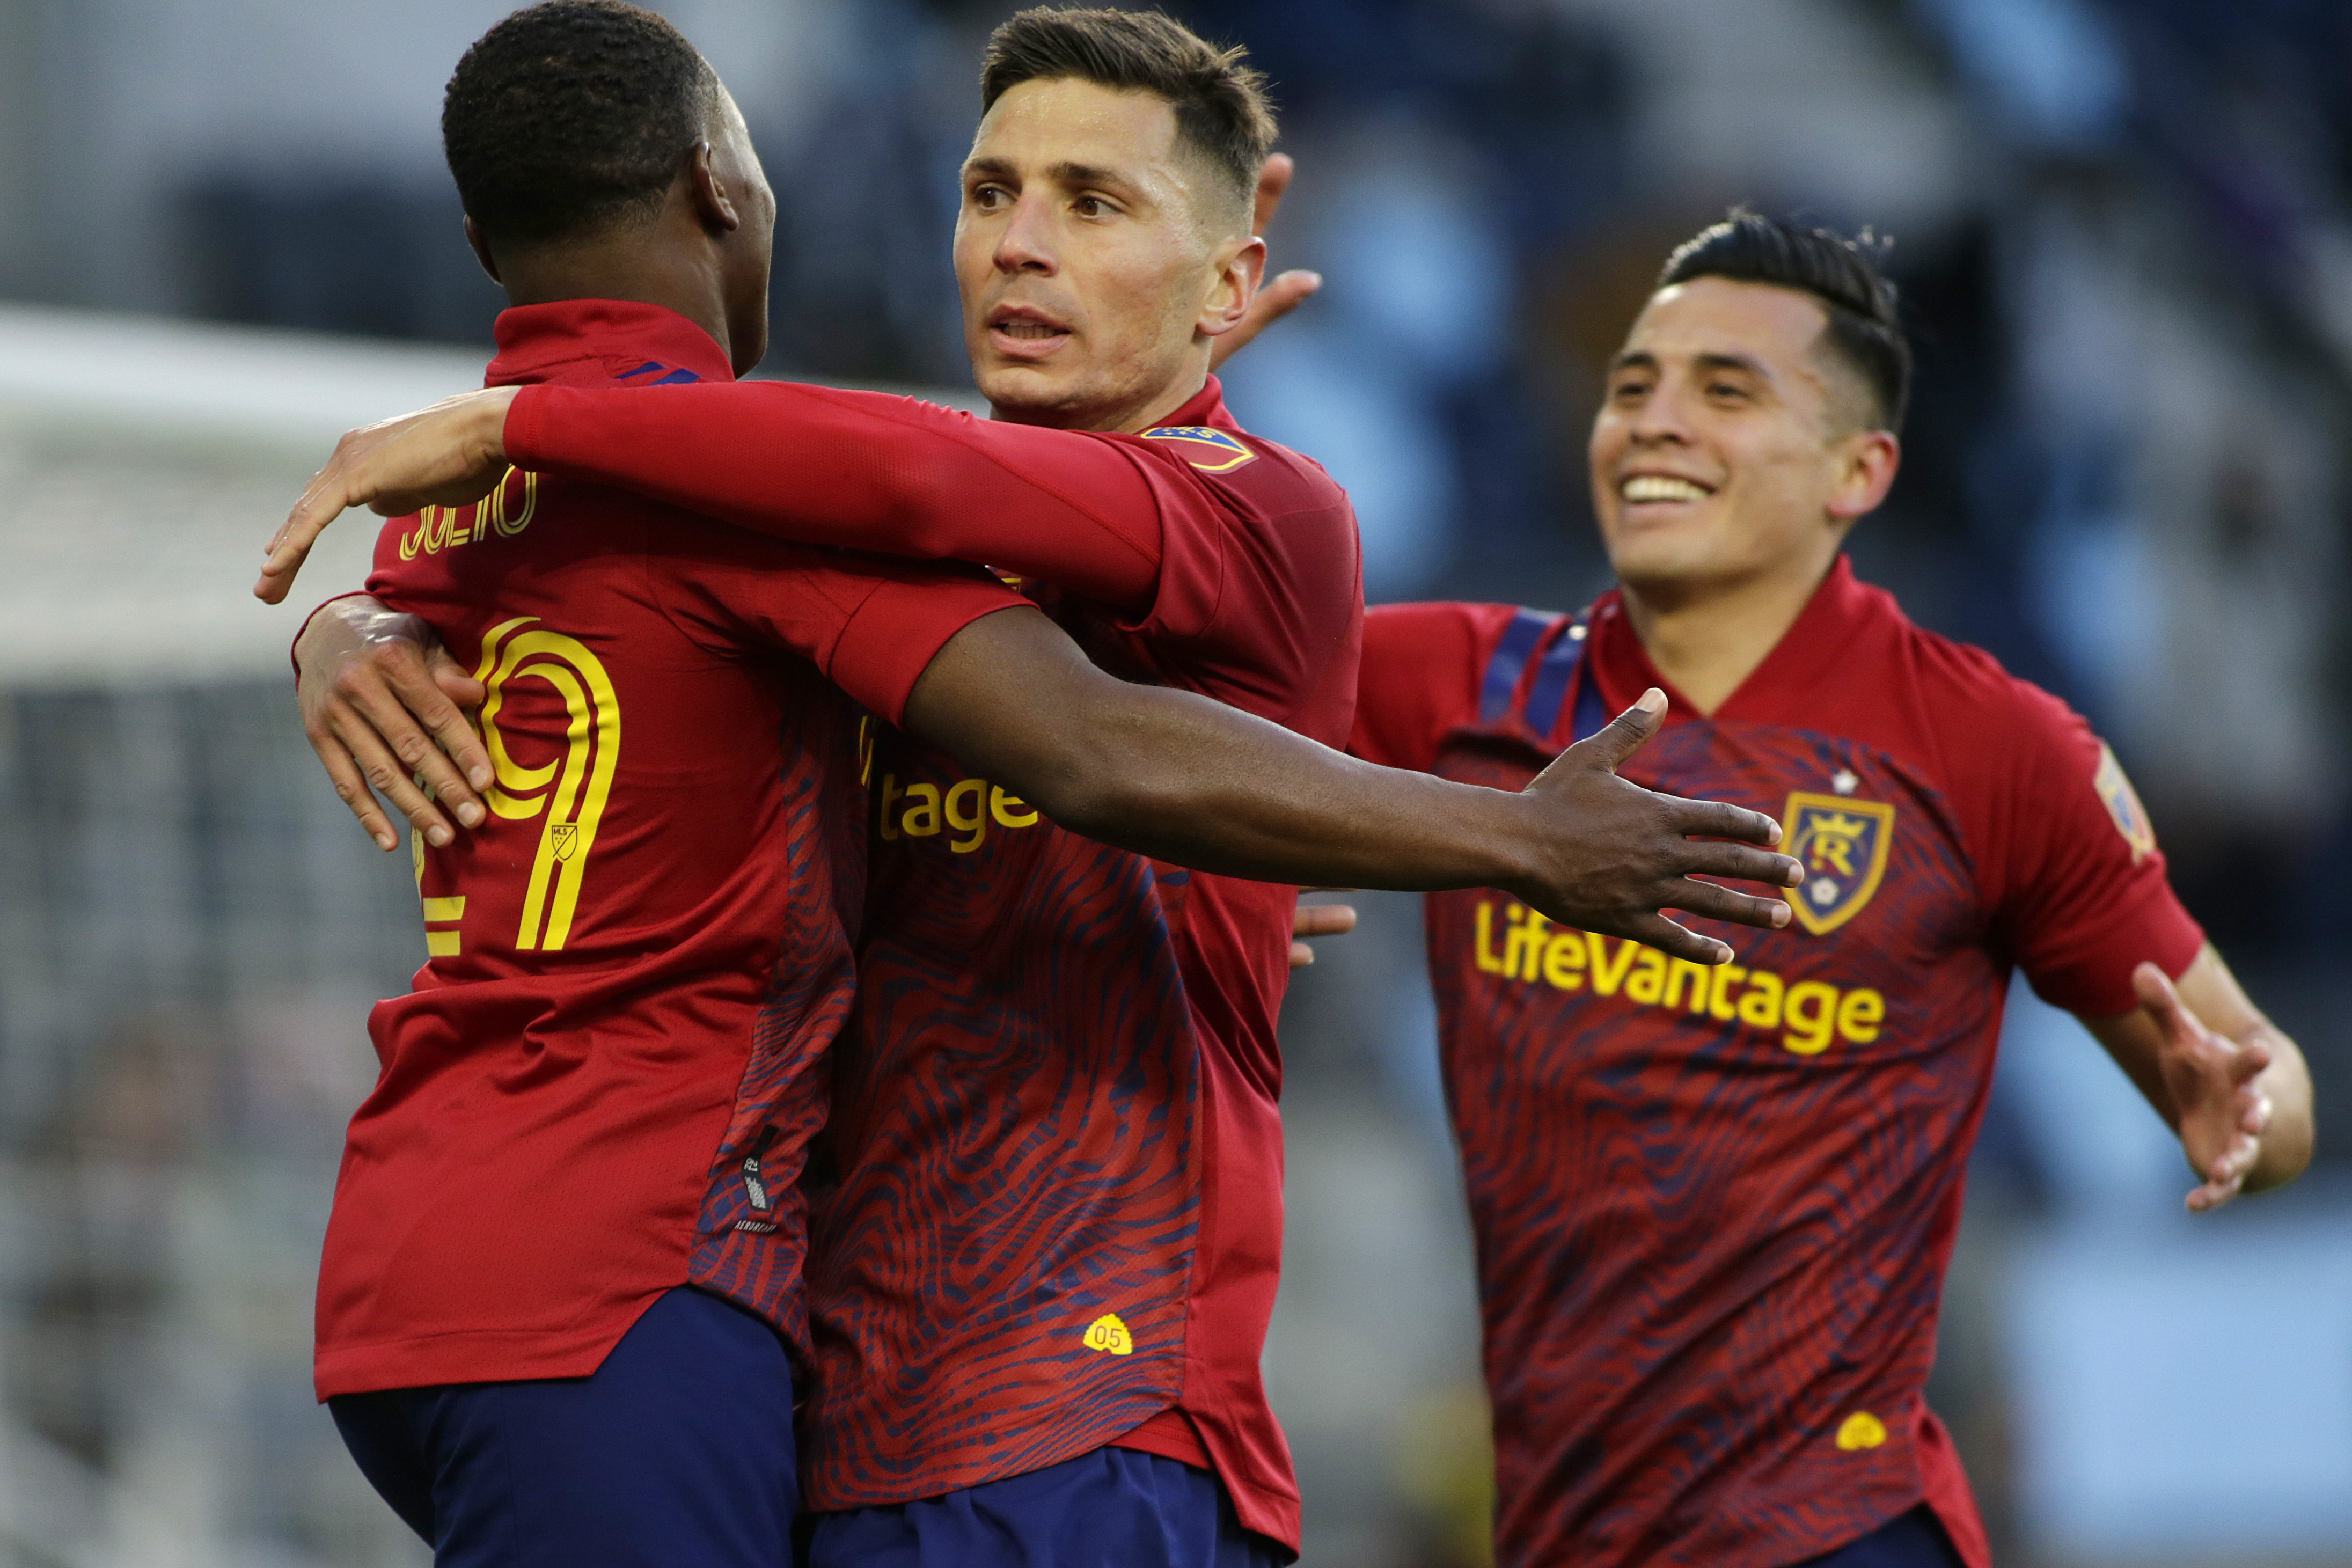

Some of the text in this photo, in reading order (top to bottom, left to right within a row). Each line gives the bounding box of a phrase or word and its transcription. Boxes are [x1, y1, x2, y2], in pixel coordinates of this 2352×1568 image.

[399, 464, 536, 561] JULIO
[1474, 900, 1885, 1055] LifeVantage
[1095, 1325, 1122, 1347] 05
